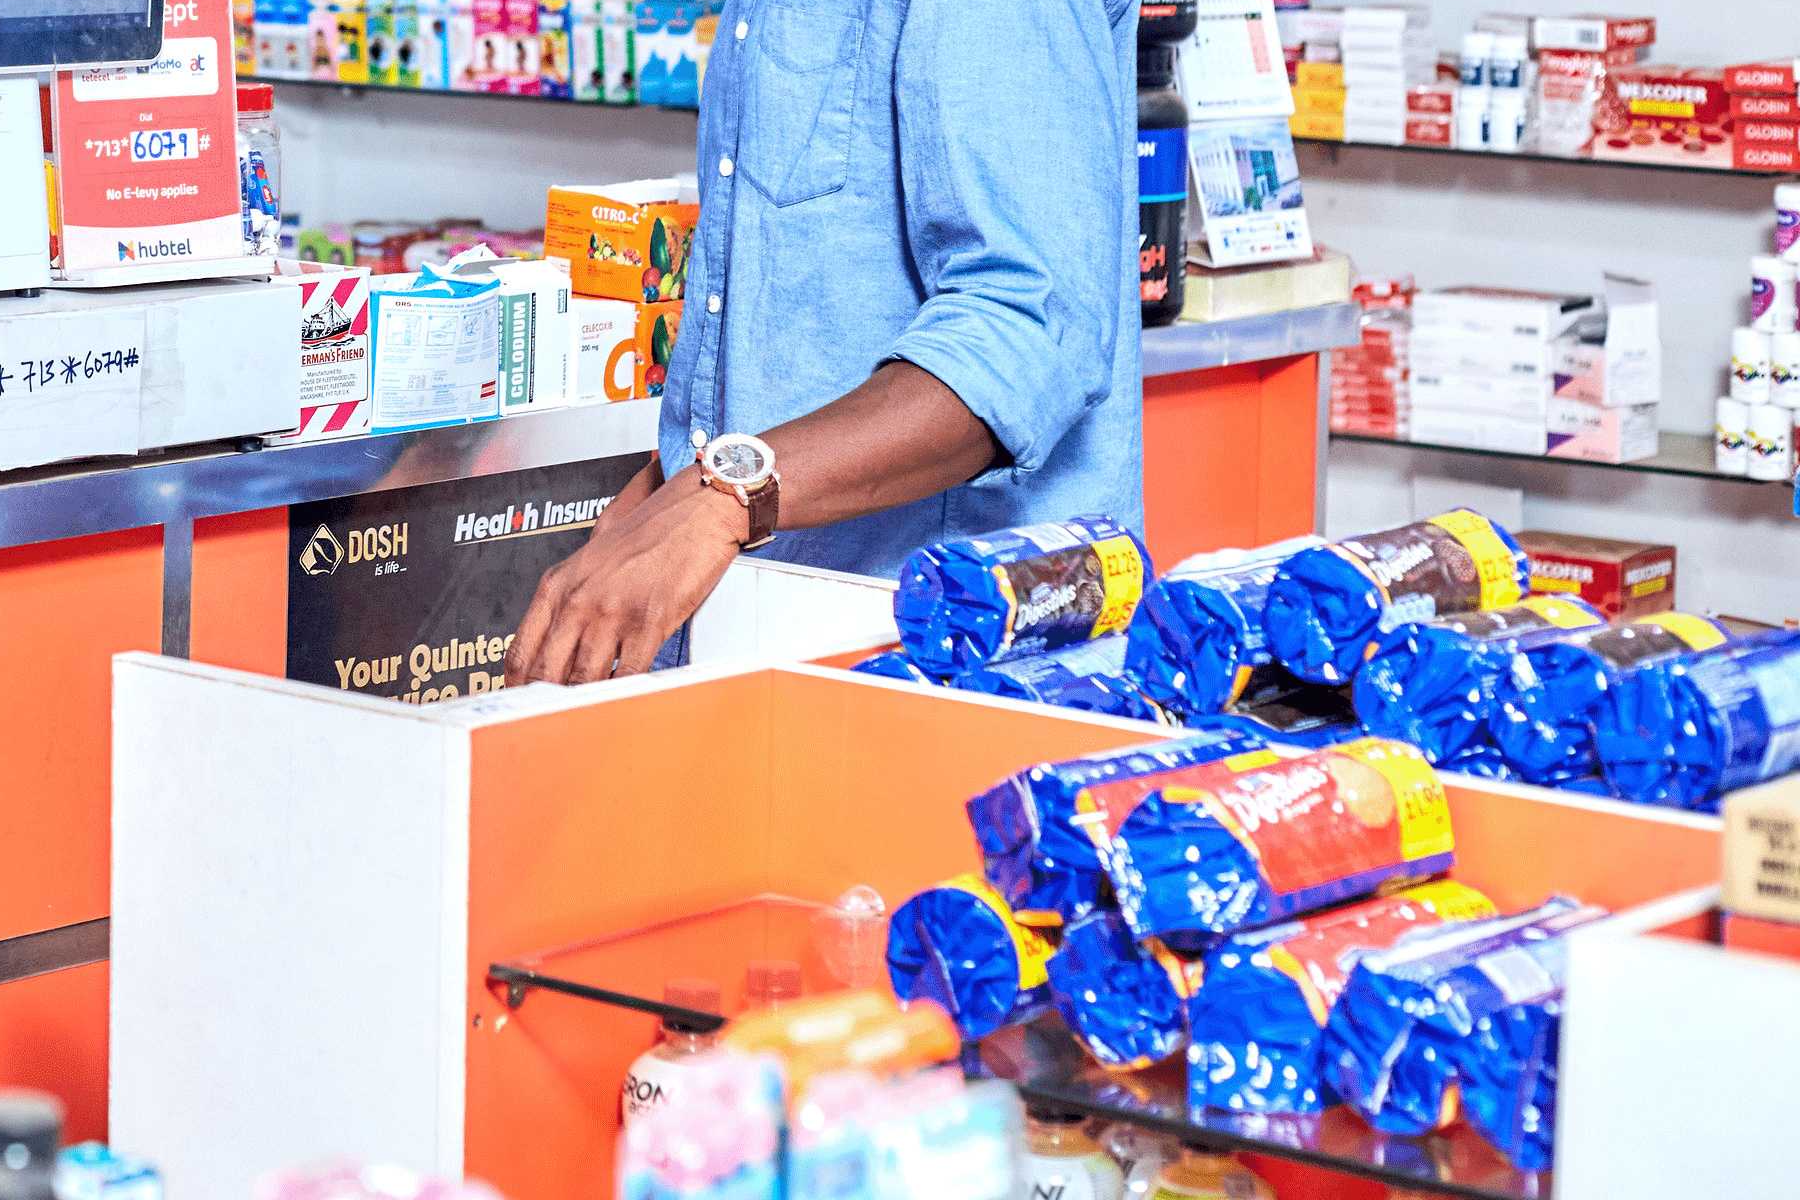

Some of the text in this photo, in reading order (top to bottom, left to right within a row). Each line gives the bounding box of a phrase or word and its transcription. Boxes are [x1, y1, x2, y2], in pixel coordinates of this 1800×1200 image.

[1735, 70, 1784, 86] GLOBIN
[1741, 98, 1790, 114] GLOBIN
[1745, 124, 1794, 141] GLOBIN
[1743, 150, 1793, 166] GLOBIN
[106, 183, 198, 200] No E-levy applies
[138, 238, 192, 258] hubtel
[510, 301, 527, 398] COLODIUM
[348, 522, 408, 564] DOSH
[335, 654, 402, 690] Your
